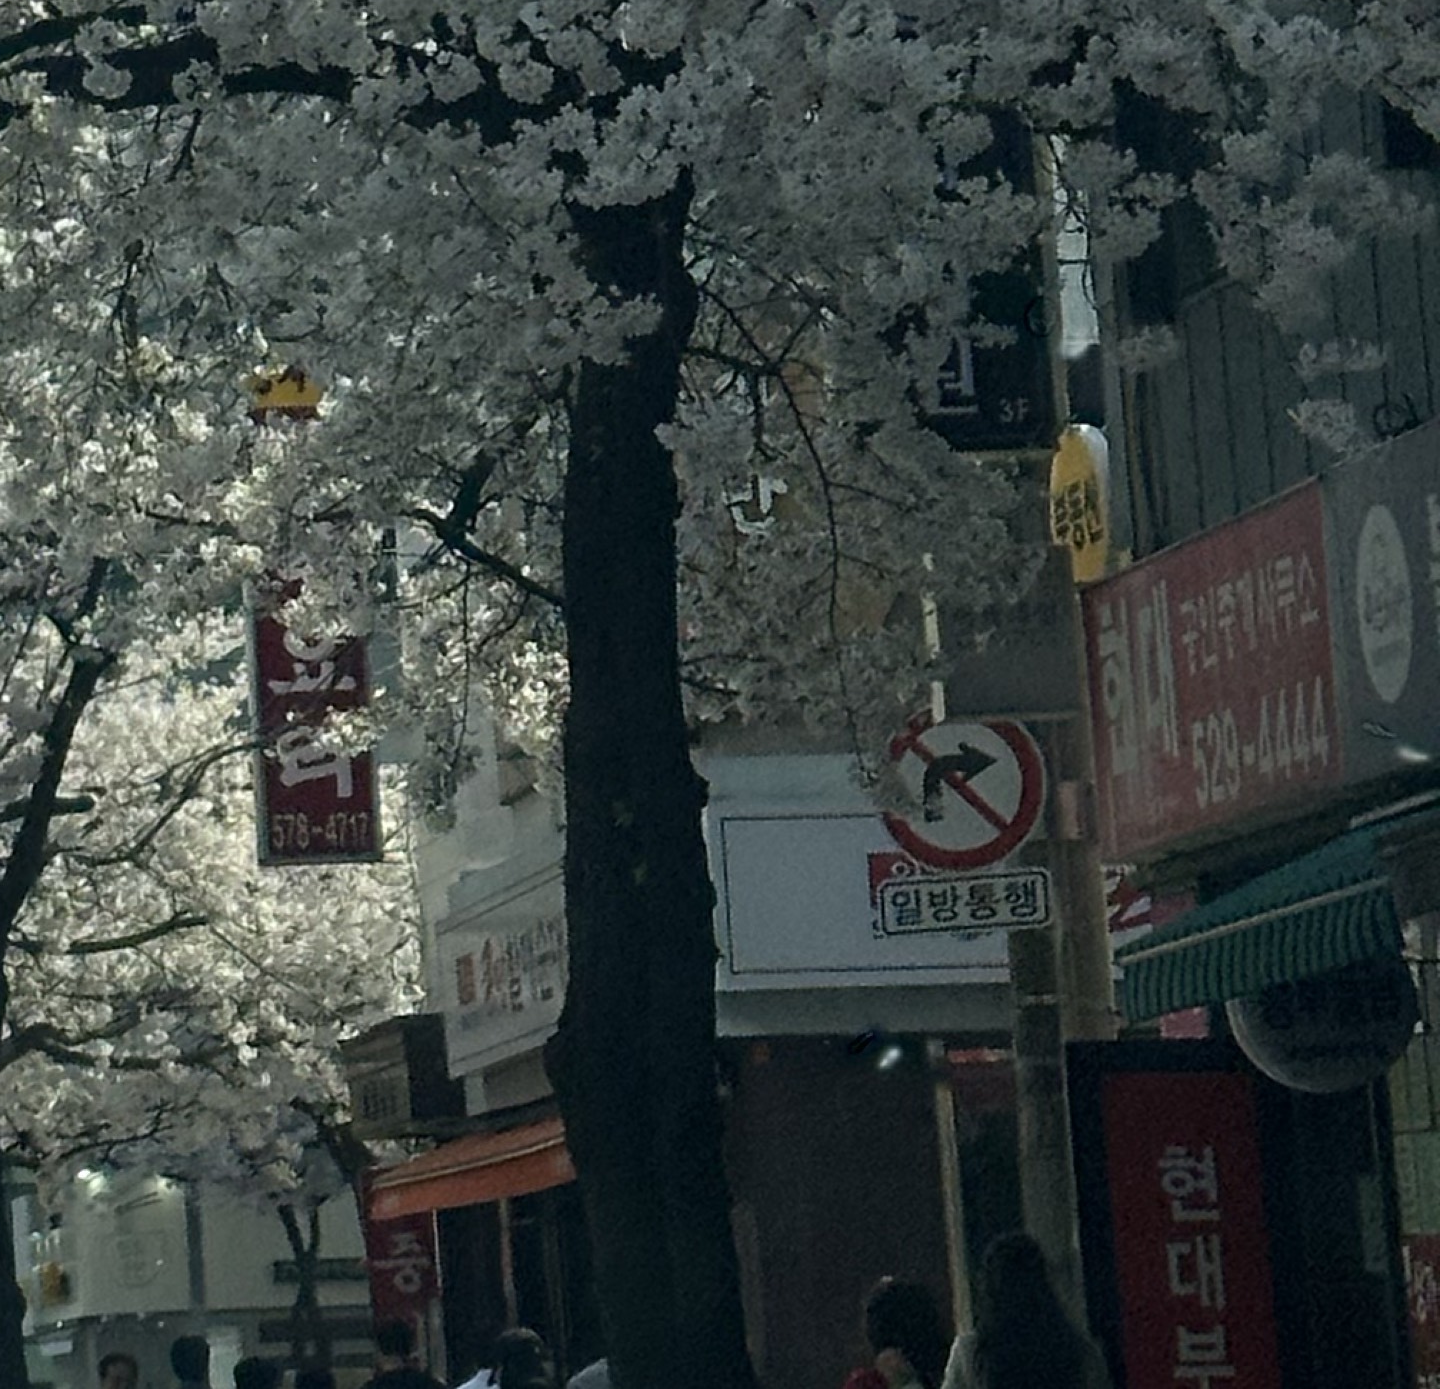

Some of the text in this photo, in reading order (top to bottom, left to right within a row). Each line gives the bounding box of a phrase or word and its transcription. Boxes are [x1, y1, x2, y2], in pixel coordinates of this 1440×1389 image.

[1096, 579, 1180, 776] 현대
[1193, 675, 1329, 810] 529-4444
[891, 879, 1038, 927] 일방통행
